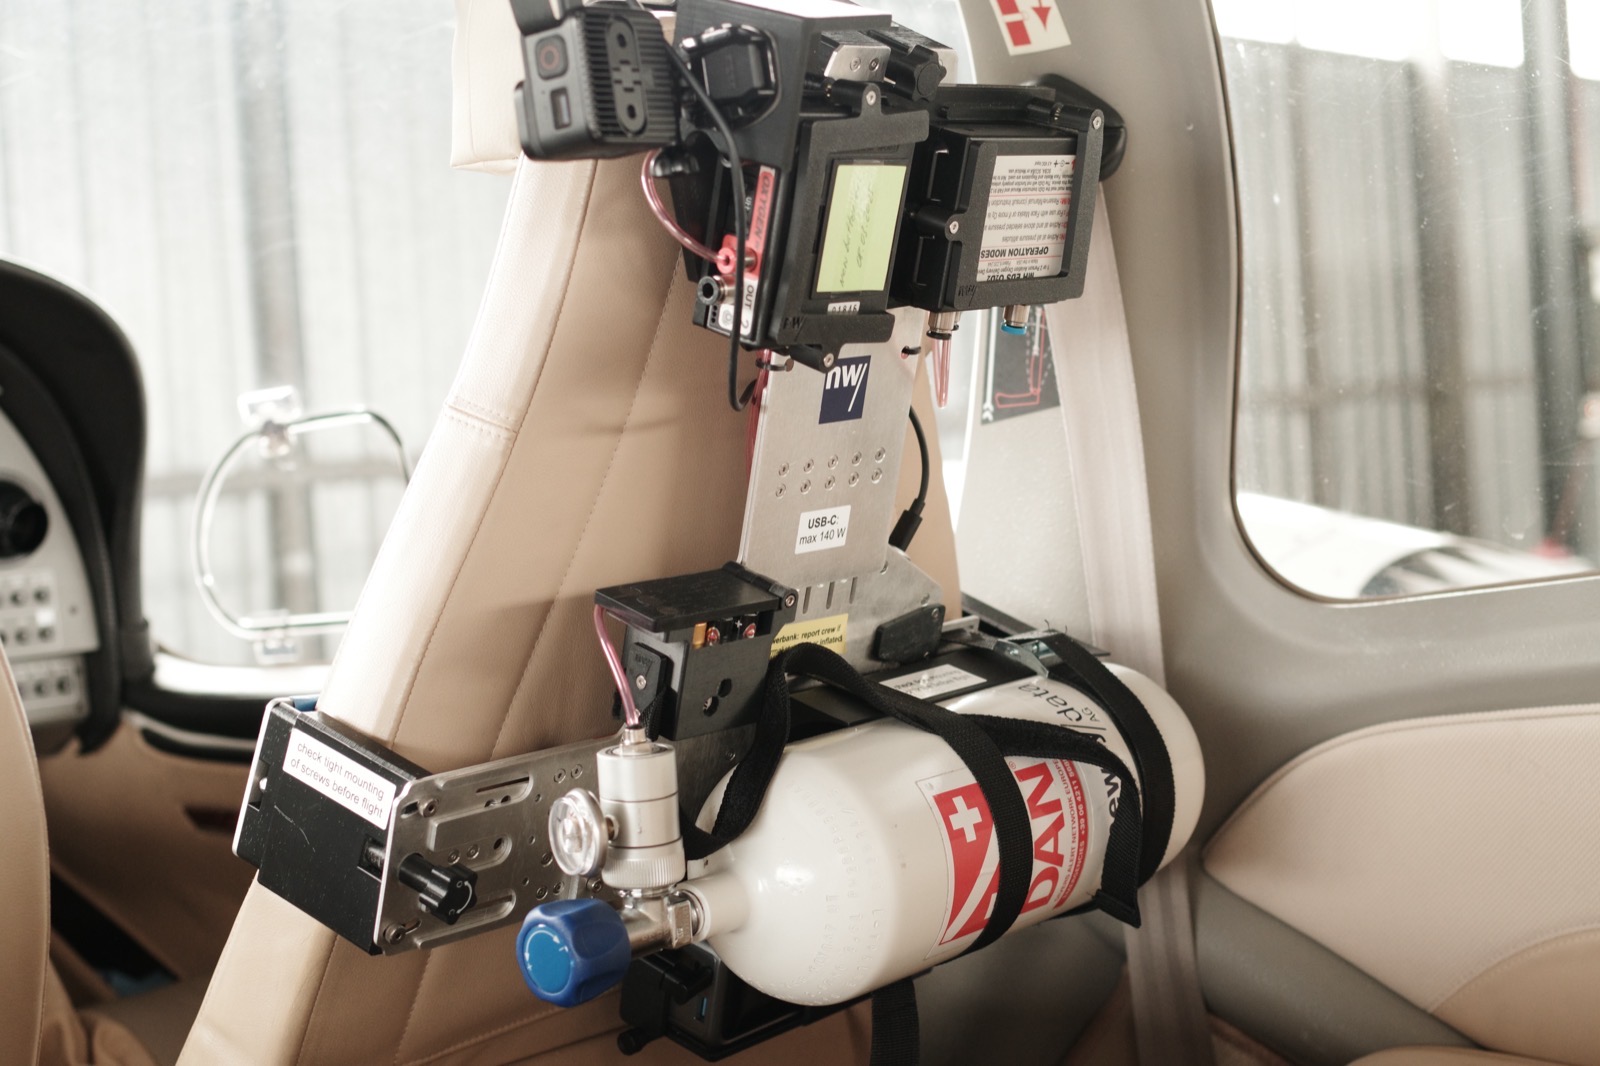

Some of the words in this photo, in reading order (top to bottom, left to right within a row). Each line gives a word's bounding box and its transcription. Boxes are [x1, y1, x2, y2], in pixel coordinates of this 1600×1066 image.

[981, 250, 1006, 258] MODES
[1008, 246, 1049, 257] OPERATION
[744, 284, 754, 310] OUT
[808, 514, 839, 529] USB-C:
[800, 535, 817, 544] max
[820, 529, 834, 542] 140
[837, 527, 846, 538] W
[802, 629, 820, 640] report
[821, 627, 836, 635] crew
[820, 634, 842, 645] inflated
[1081, 707, 1101, 722] AG
[297, 742, 322, 762] check
[324, 757, 343, 776] tight
[344, 770, 385, 802] mounting
[1052, 760, 1071, 795] EUROPE
[290, 758, 302, 770] of
[301, 764, 330, 788] screws
[332, 779, 360, 804] before
[362, 798, 385, 818] flight
[1067, 798, 1078, 844] NETWORK
[1013, 762, 1065, 914] DAN
[1066, 846, 1076, 874] ALERT
